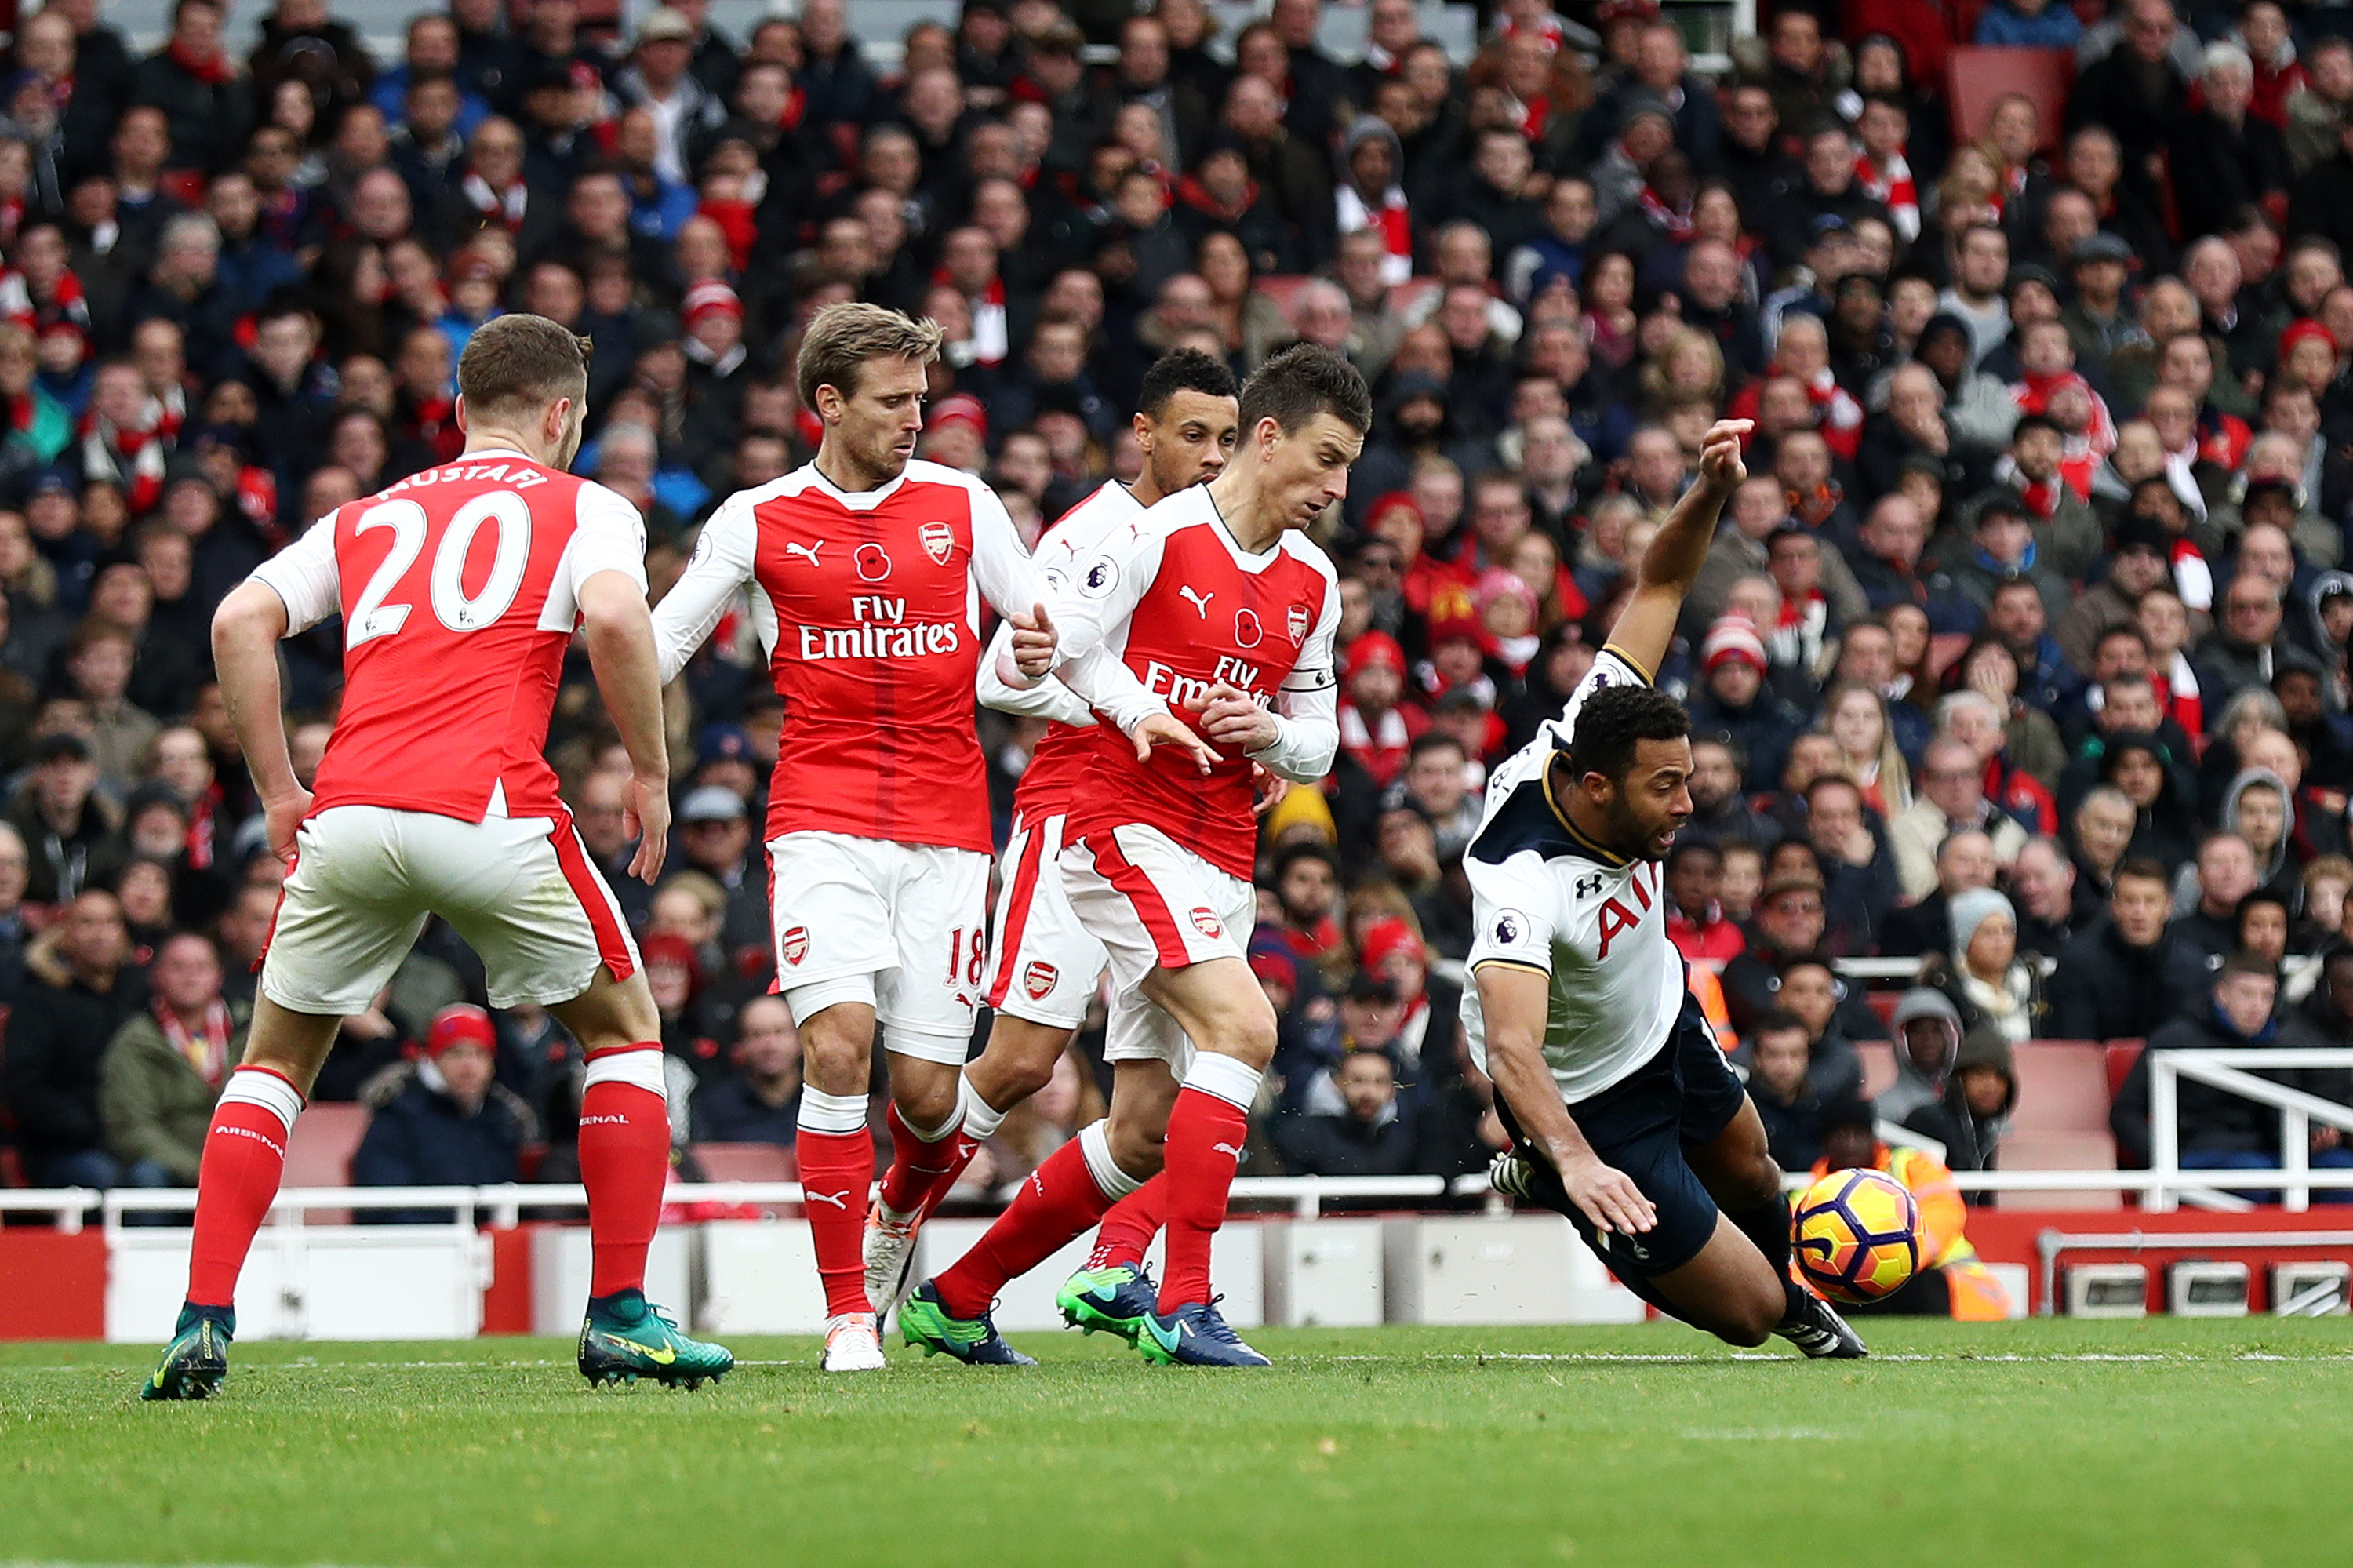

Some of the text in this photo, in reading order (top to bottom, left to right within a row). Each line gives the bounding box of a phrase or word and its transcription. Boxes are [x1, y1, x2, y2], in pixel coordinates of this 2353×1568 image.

[347, 490, 532, 651] 20
[851, 595, 906, 624] Fly
[798, 621, 958, 660] Emirates
[1213, 655, 1259, 689] Fly
[943, 926, 984, 988] 18
